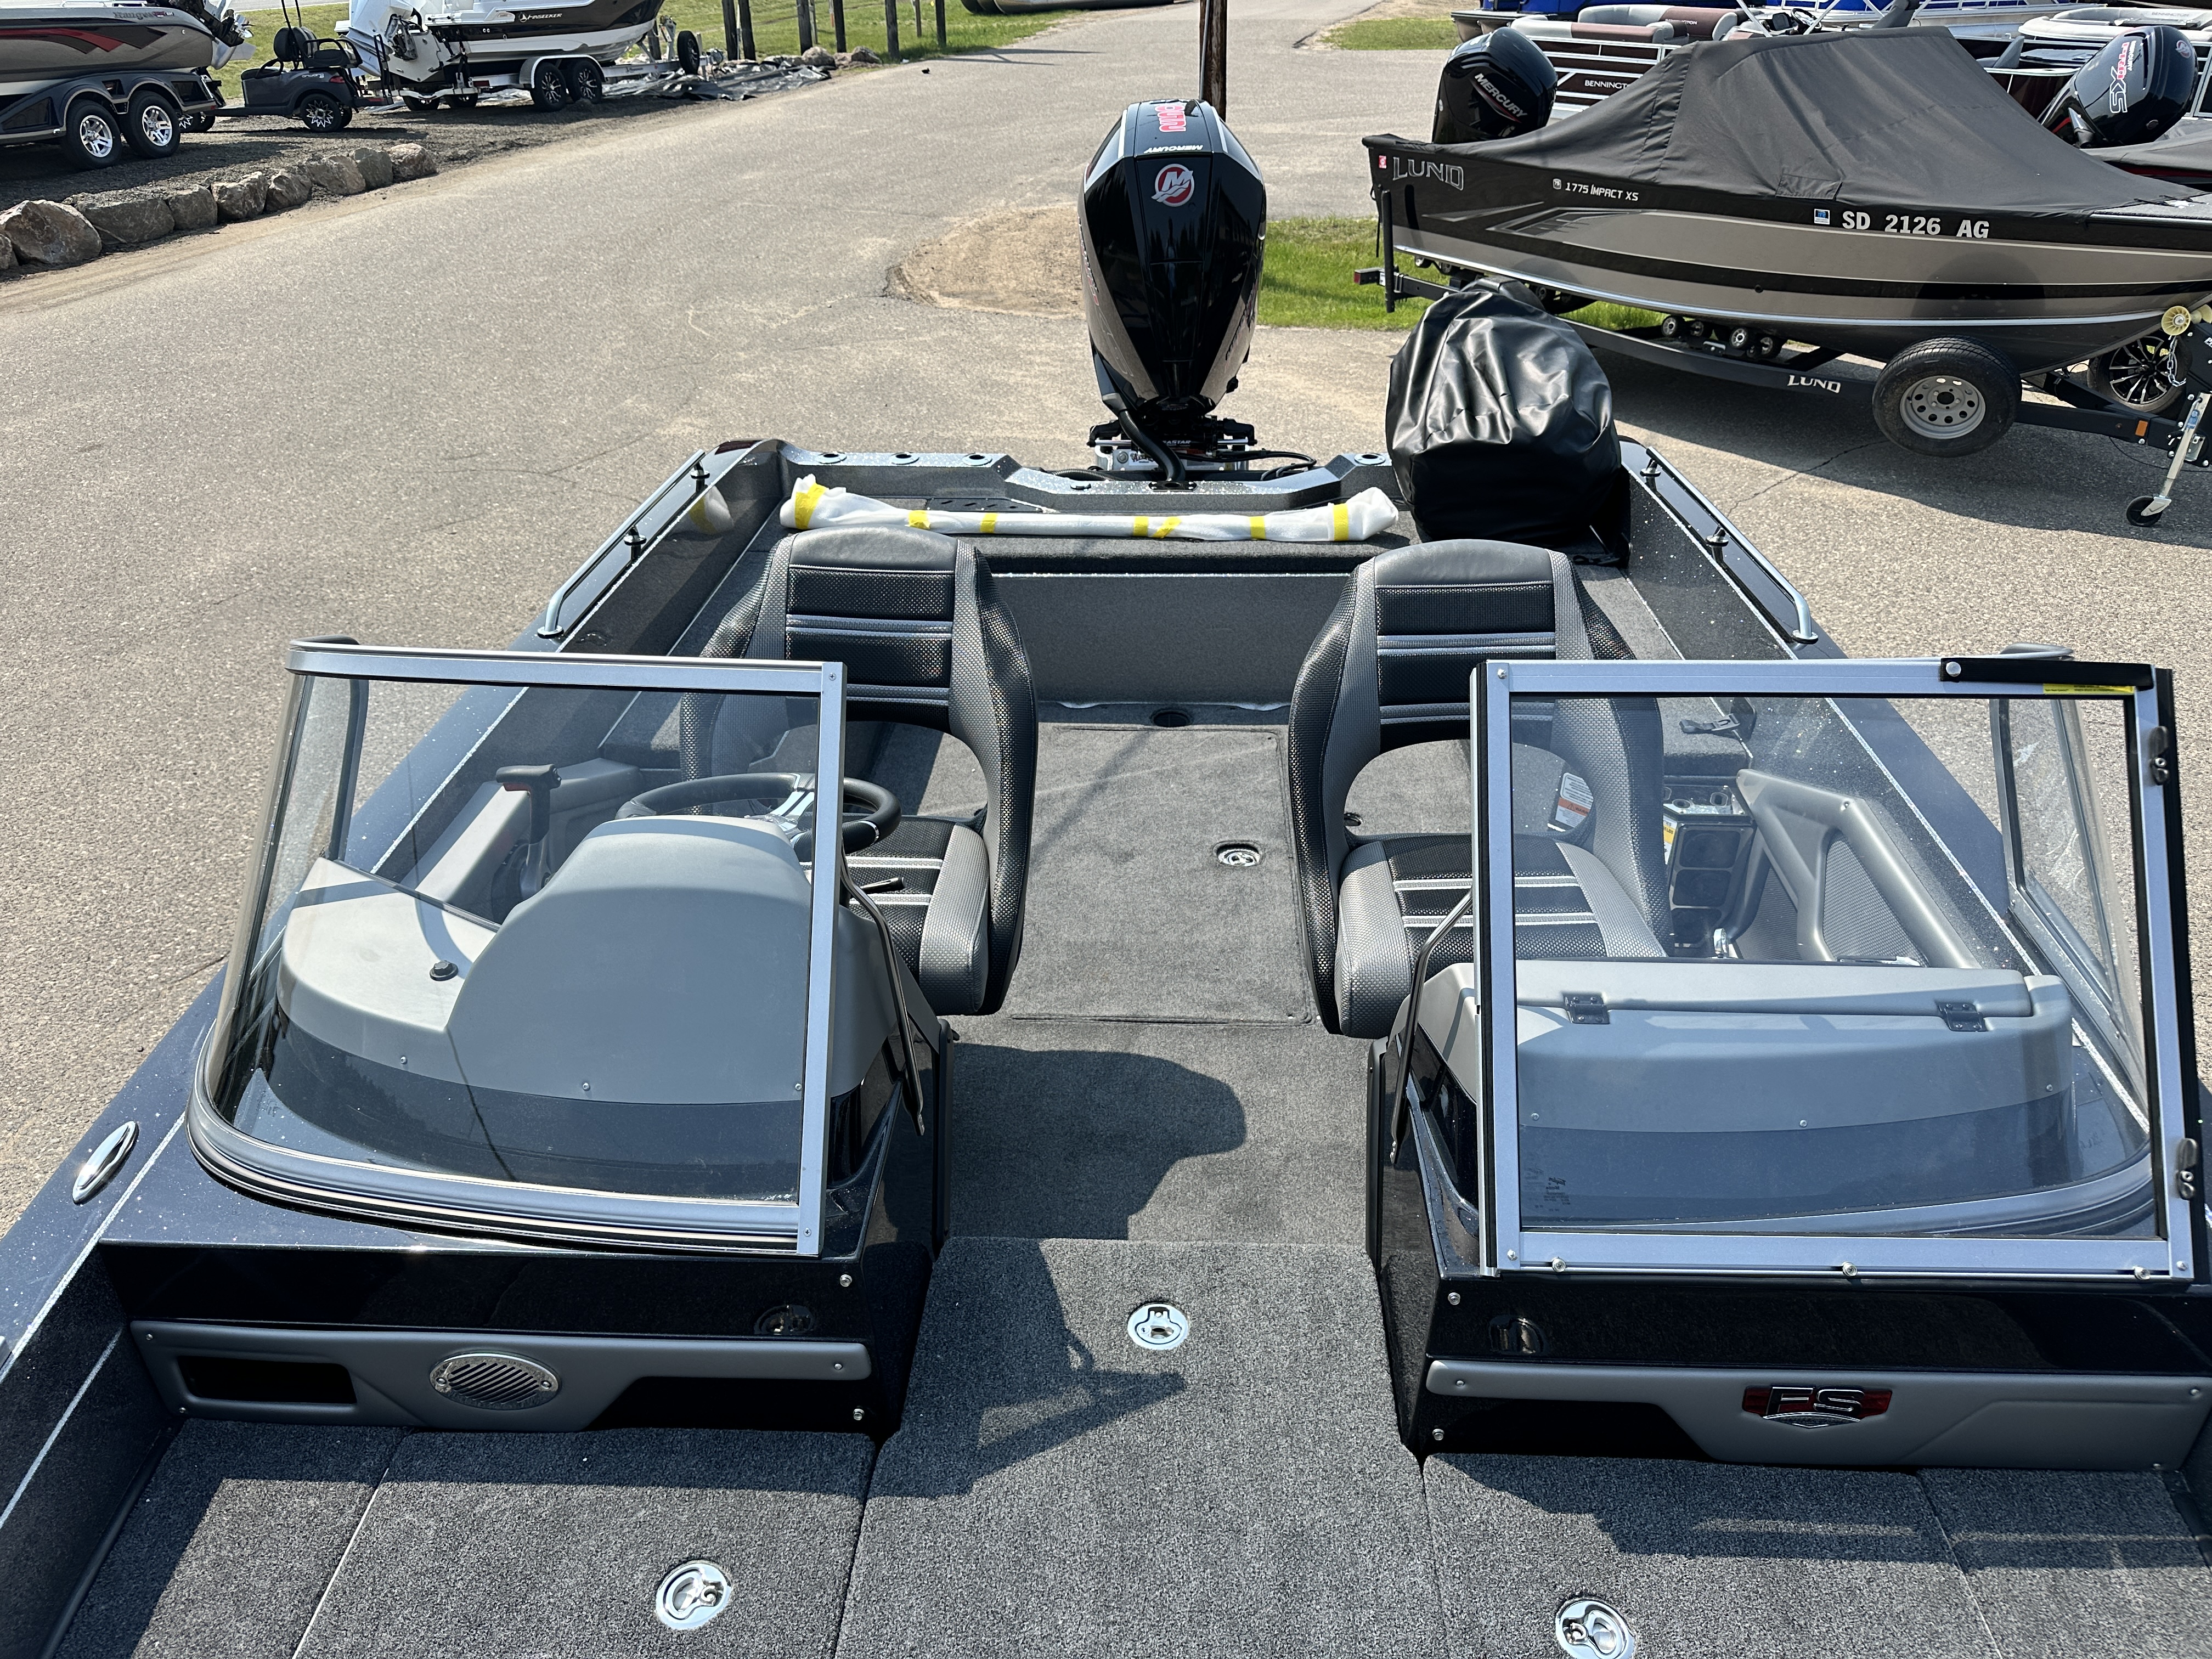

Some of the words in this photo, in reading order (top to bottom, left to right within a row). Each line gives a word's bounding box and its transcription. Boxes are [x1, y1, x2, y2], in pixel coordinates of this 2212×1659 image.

[1474, 73, 1528, 117] MERCURY
[1584, 80, 1629, 89] BENNINGT
[2109, 66, 2128, 114] XS
[1143, 145, 1203, 154] MERCURY
[1392, 156, 1464, 191] LUND
[1565, 182, 1589, 194] 1775
[1590, 184, 1623, 199] IMPACT
[1625, 191, 1639, 201] XS
[1842, 211, 1871, 230] SD
[1884, 215, 1941, 235] 2126
[1956, 219, 1990, 238] AG
[1787, 375, 1841, 393] LUND
[1765, 1385, 1865, 1418] FS
